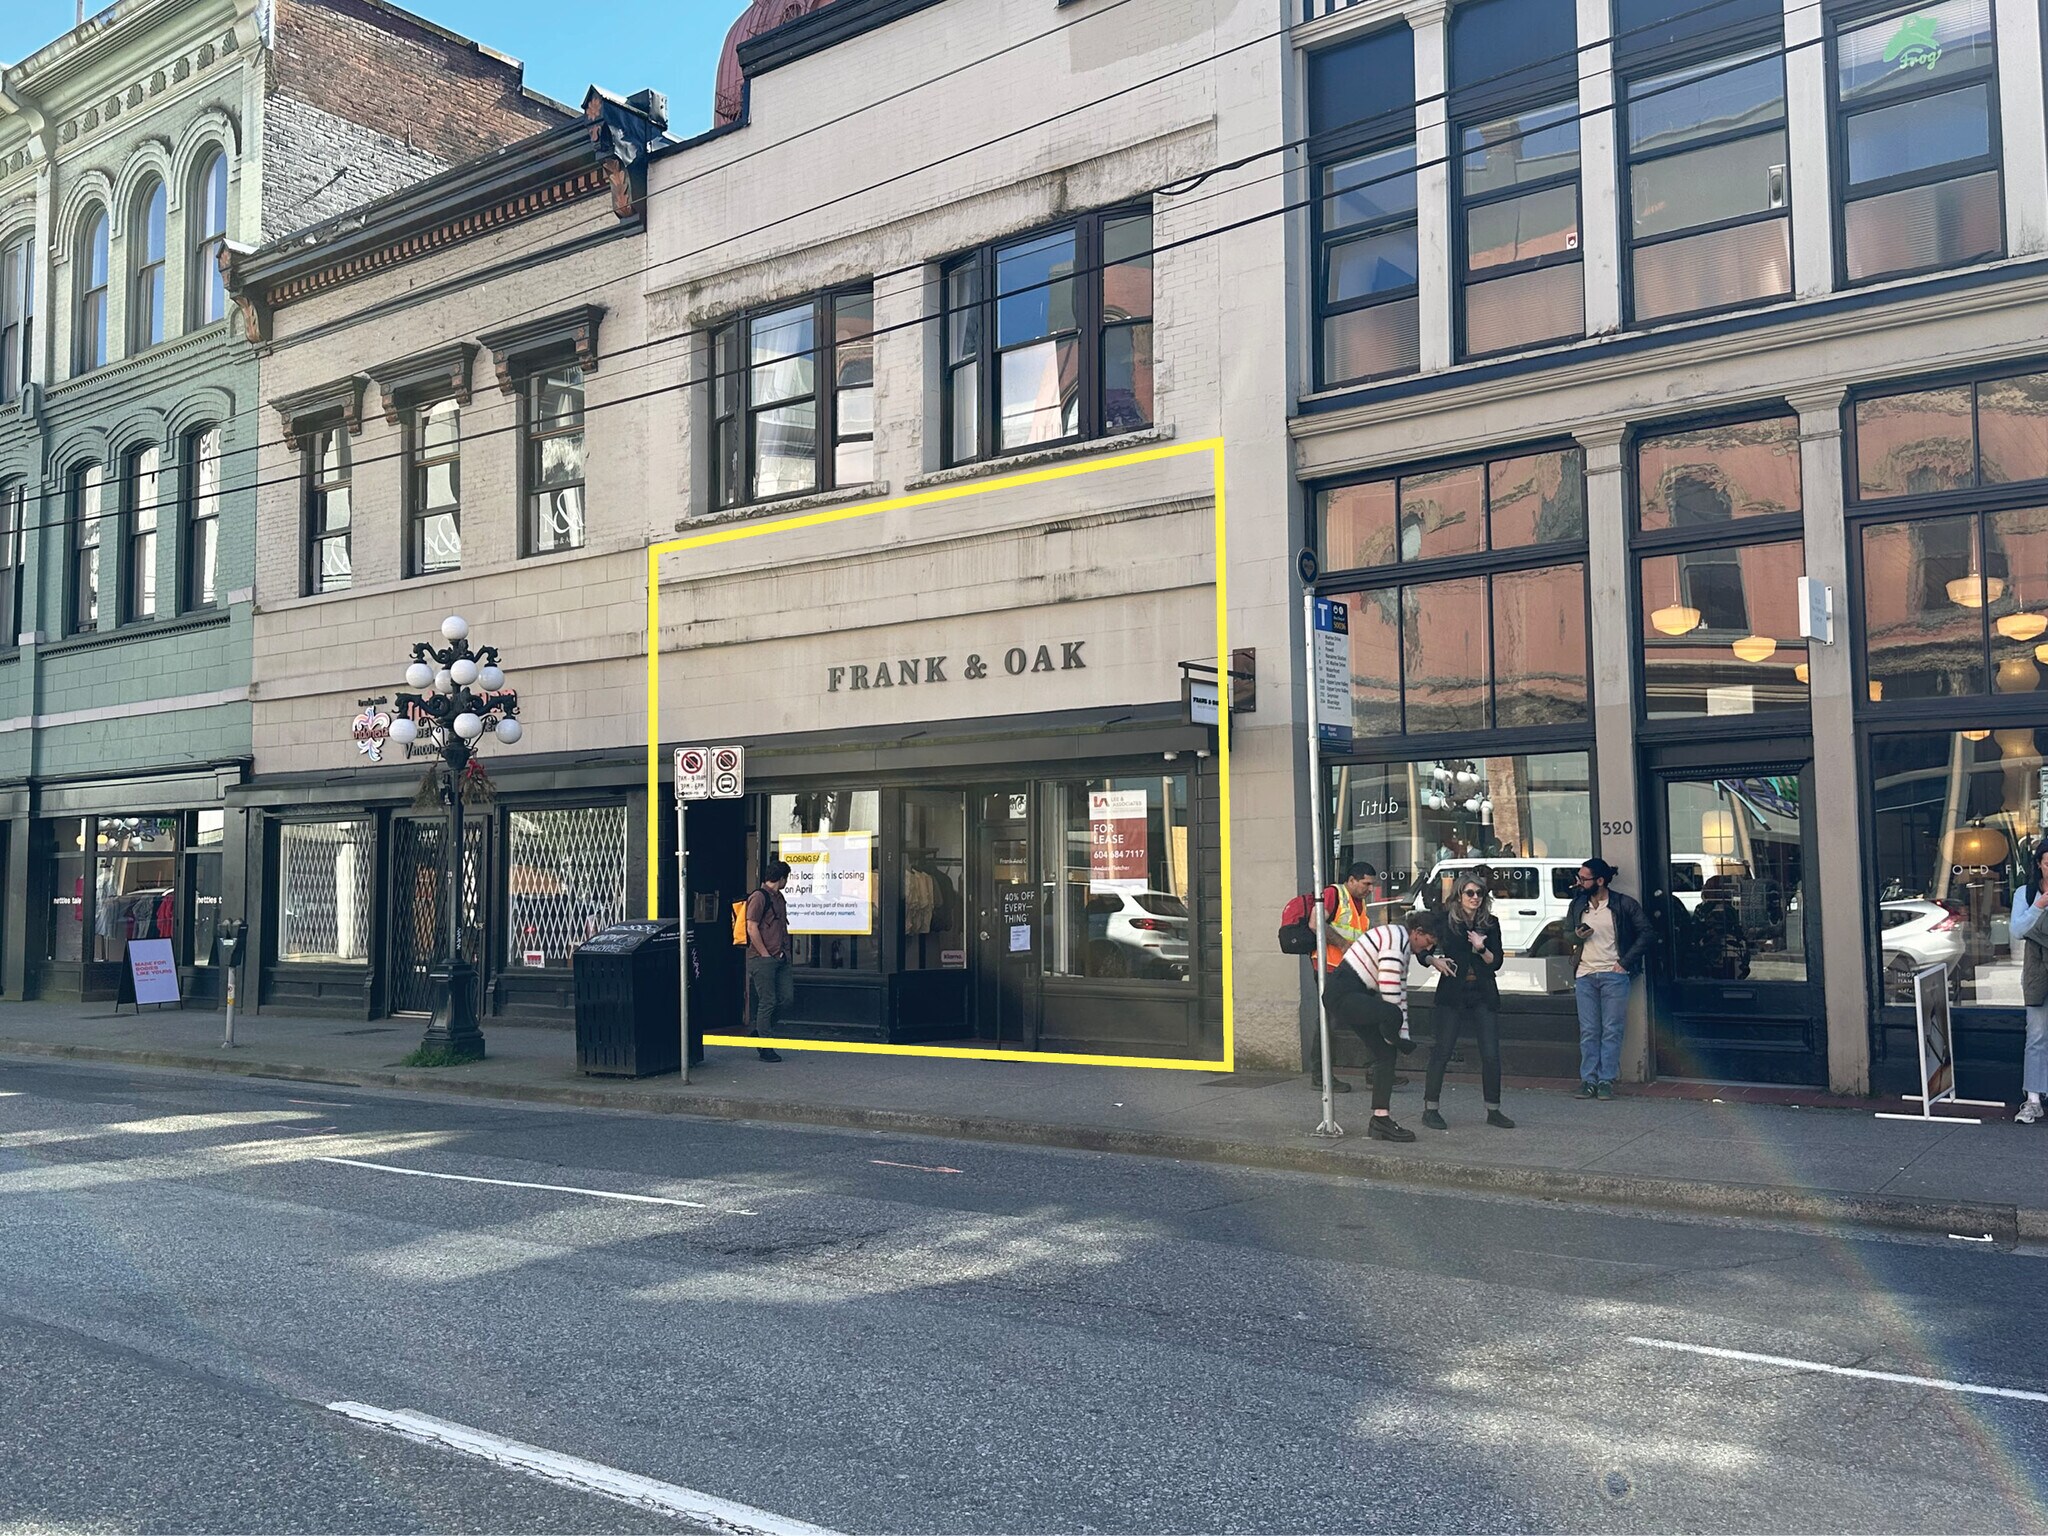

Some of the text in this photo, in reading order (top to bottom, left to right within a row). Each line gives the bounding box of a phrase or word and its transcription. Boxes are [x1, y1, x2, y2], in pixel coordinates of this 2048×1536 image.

[827, 641, 1086, 692] FRANK & OAK
[1094, 824, 1114, 833] FOR
[1602, 821, 1633, 835] 320
[1094, 835, 1124, 844] LEASE
[1094, 850, 1107, 859] 604
[1111, 850, 1124, 858] 684
[1952, 864, 1989, 875] OLD
[838, 870, 864, 882] closing
[1380, 872, 1406, 880] OLD
[1494, 871, 1532, 880] SHOP
[785, 886, 794, 894] on
[795, 884, 812, 895] April
[1005, 891, 1034, 901] 40% OFF
